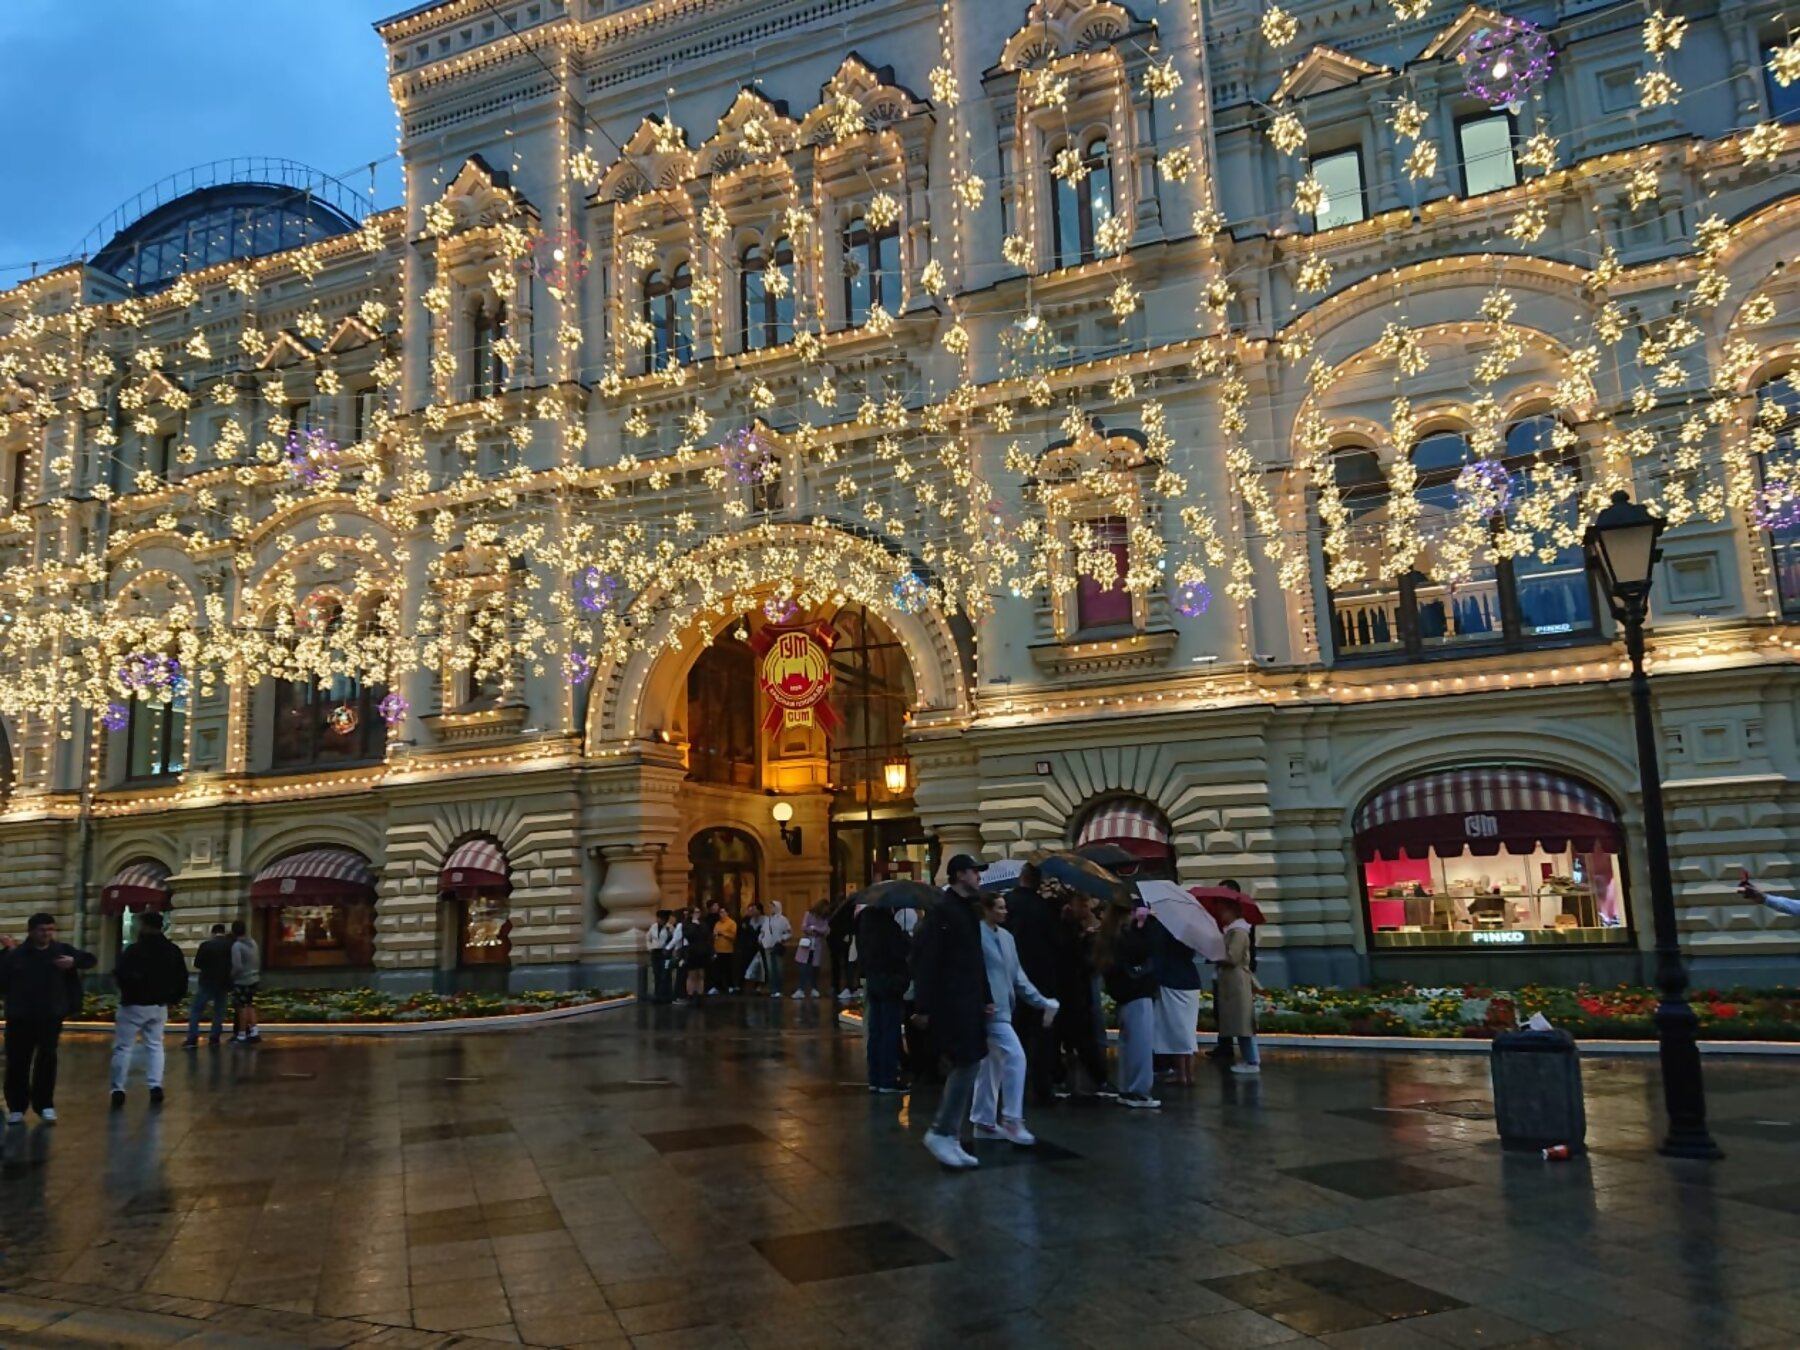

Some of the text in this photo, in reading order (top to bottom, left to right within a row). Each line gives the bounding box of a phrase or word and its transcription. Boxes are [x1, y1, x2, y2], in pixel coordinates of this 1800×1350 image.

[780, 636, 808, 659] ГУМ
[787, 711, 810, 723] GUM
[1472, 931, 1525, 942] PINKO
